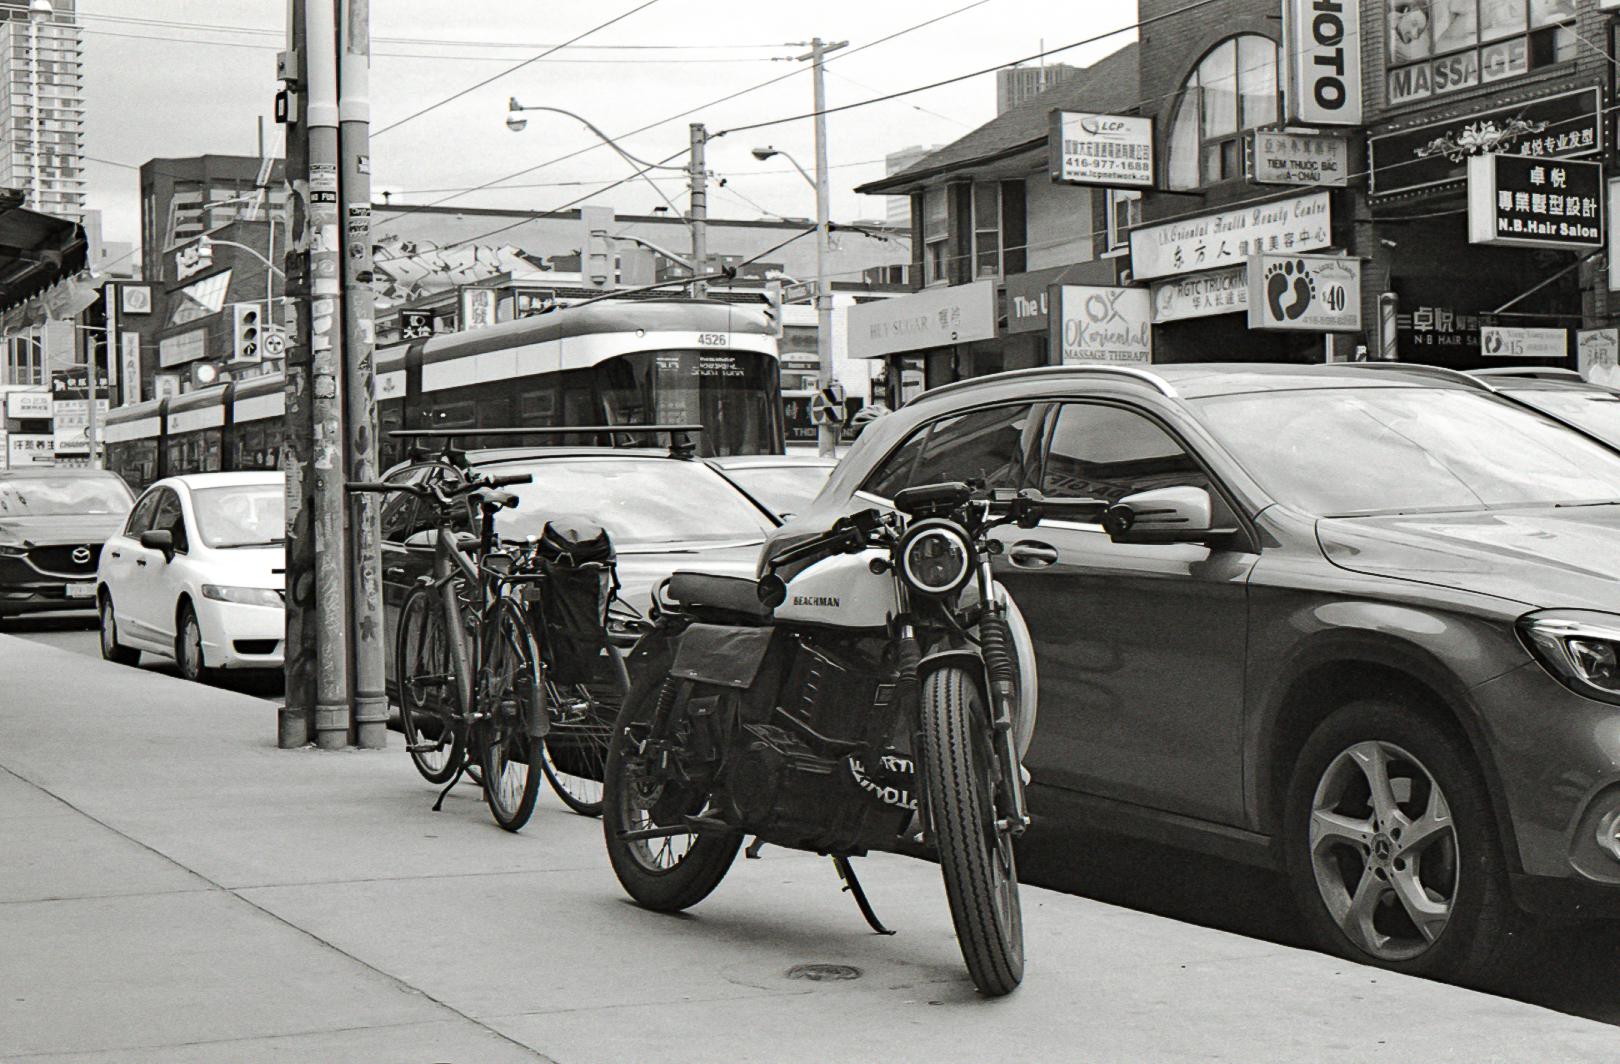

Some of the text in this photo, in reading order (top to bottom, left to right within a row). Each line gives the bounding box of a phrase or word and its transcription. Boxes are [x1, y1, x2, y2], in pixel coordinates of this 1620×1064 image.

[1392, 38, 1526, 98] MASSAGE
[1101, 122, 1125, 131] LCP
[1066, 158, 1150, 171] 416-977-1688
[1560, 222, 1599, 237] Salon
[1013, 295, 1038, 318] The
[698, 334, 726, 346] 4526
[1064, 350, 1149, 363] MASSAGE THERAPY
[793, 596, 840, 608] BEACHMAN
